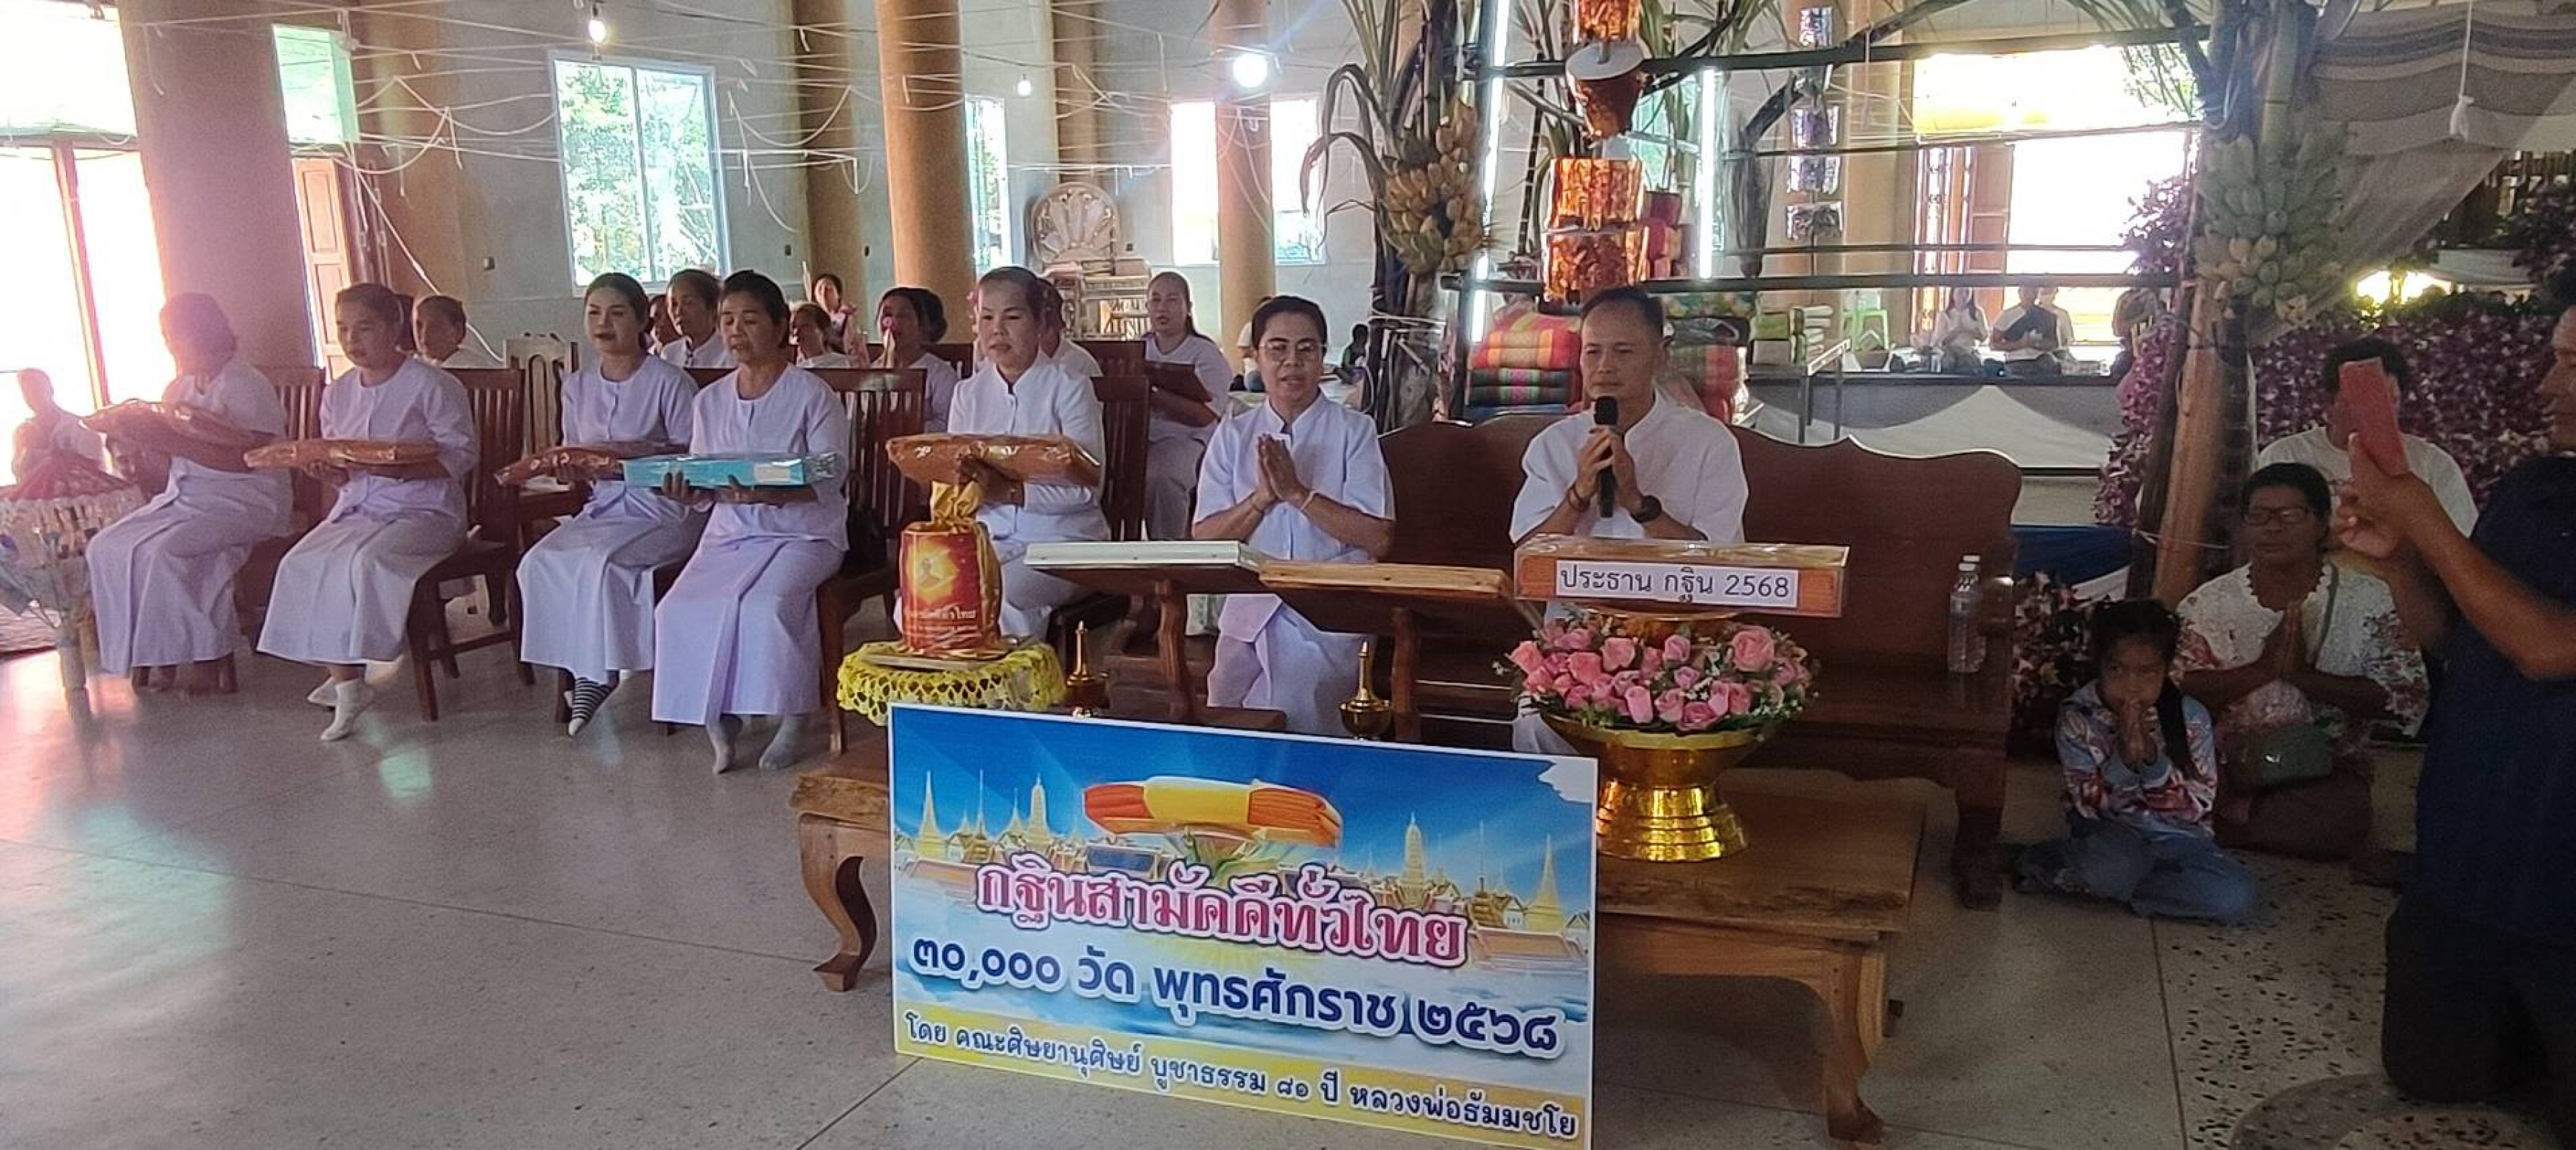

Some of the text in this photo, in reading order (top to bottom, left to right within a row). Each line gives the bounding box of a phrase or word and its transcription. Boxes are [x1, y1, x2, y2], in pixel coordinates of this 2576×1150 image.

[1561, 565, 1789, 604] ประธาน กฐิน 2568
[979, 856, 1464, 962] กฐินสามัคคีทั่วไทย
[913, 937, 1557, 1051] ๓๐,๐๐๐ วัด พุทธศักราช ๒๕๖๘
[905, 1011, 1576, 1136] โดย คณะศิษยานุศิษย์ บูชาธรรม ๘๑ ปี หลวงพ่อธัมมชโย
